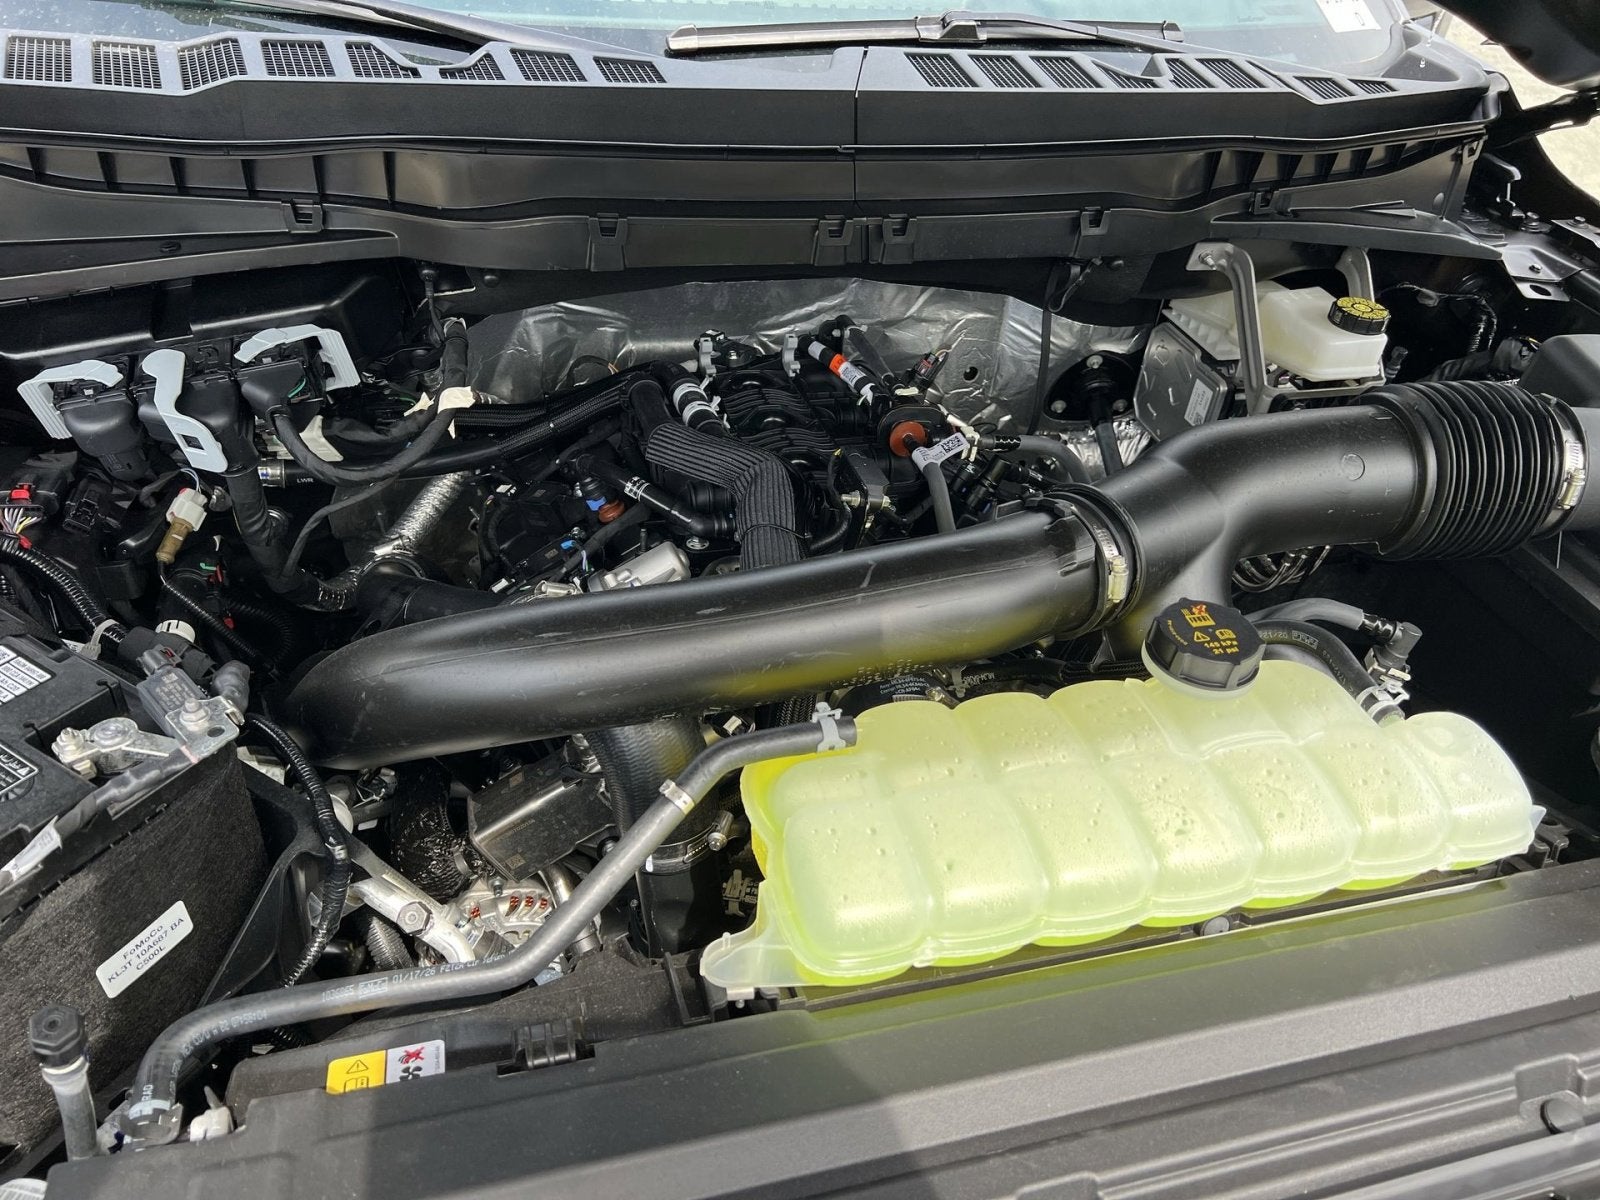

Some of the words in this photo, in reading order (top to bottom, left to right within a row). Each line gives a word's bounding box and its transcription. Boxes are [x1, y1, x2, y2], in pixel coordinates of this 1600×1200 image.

[1226, 646, 1239, 654] psi
[108, 959, 132, 983] KL3T
[136, 930, 168, 959] 10A687
[170, 918, 184, 931] BA
[123, 925, 163, 959] FoMoCo
[136, 945, 166, 971] C500L
